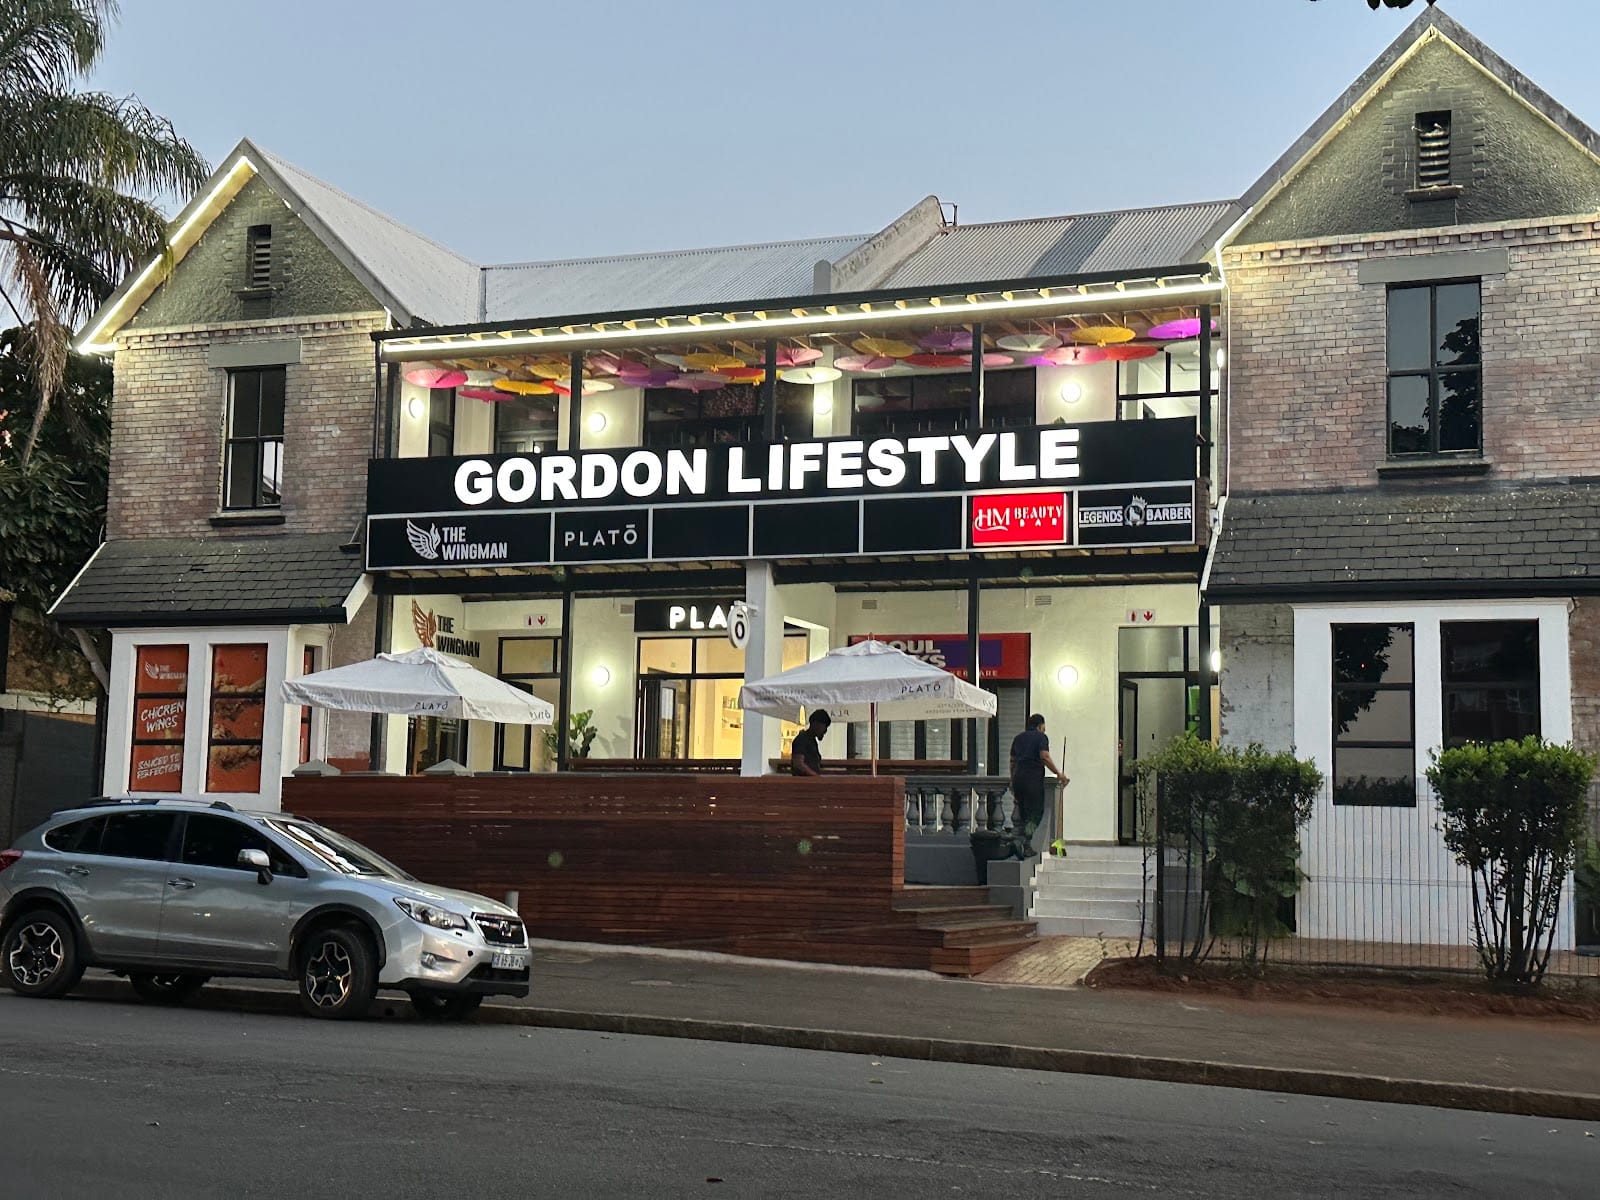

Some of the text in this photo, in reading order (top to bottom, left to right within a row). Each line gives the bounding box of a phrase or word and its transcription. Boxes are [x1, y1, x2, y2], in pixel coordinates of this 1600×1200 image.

[454, 428, 1080, 505] GORDON LIFESTYLE
[974, 507, 1010, 531] HM
[1014, 506, 1063, 519] BEAUTY
[1079, 507, 1191, 524] LEGENDS BARBER
[442, 526, 467, 542] THE
[441, 542, 508, 561] WINGMAN
[437, 614, 454, 633] THE
[669, 604, 747, 630] PLA
[436, 635, 480, 658] WINGMAN
[883, 640, 941, 654] OUL
